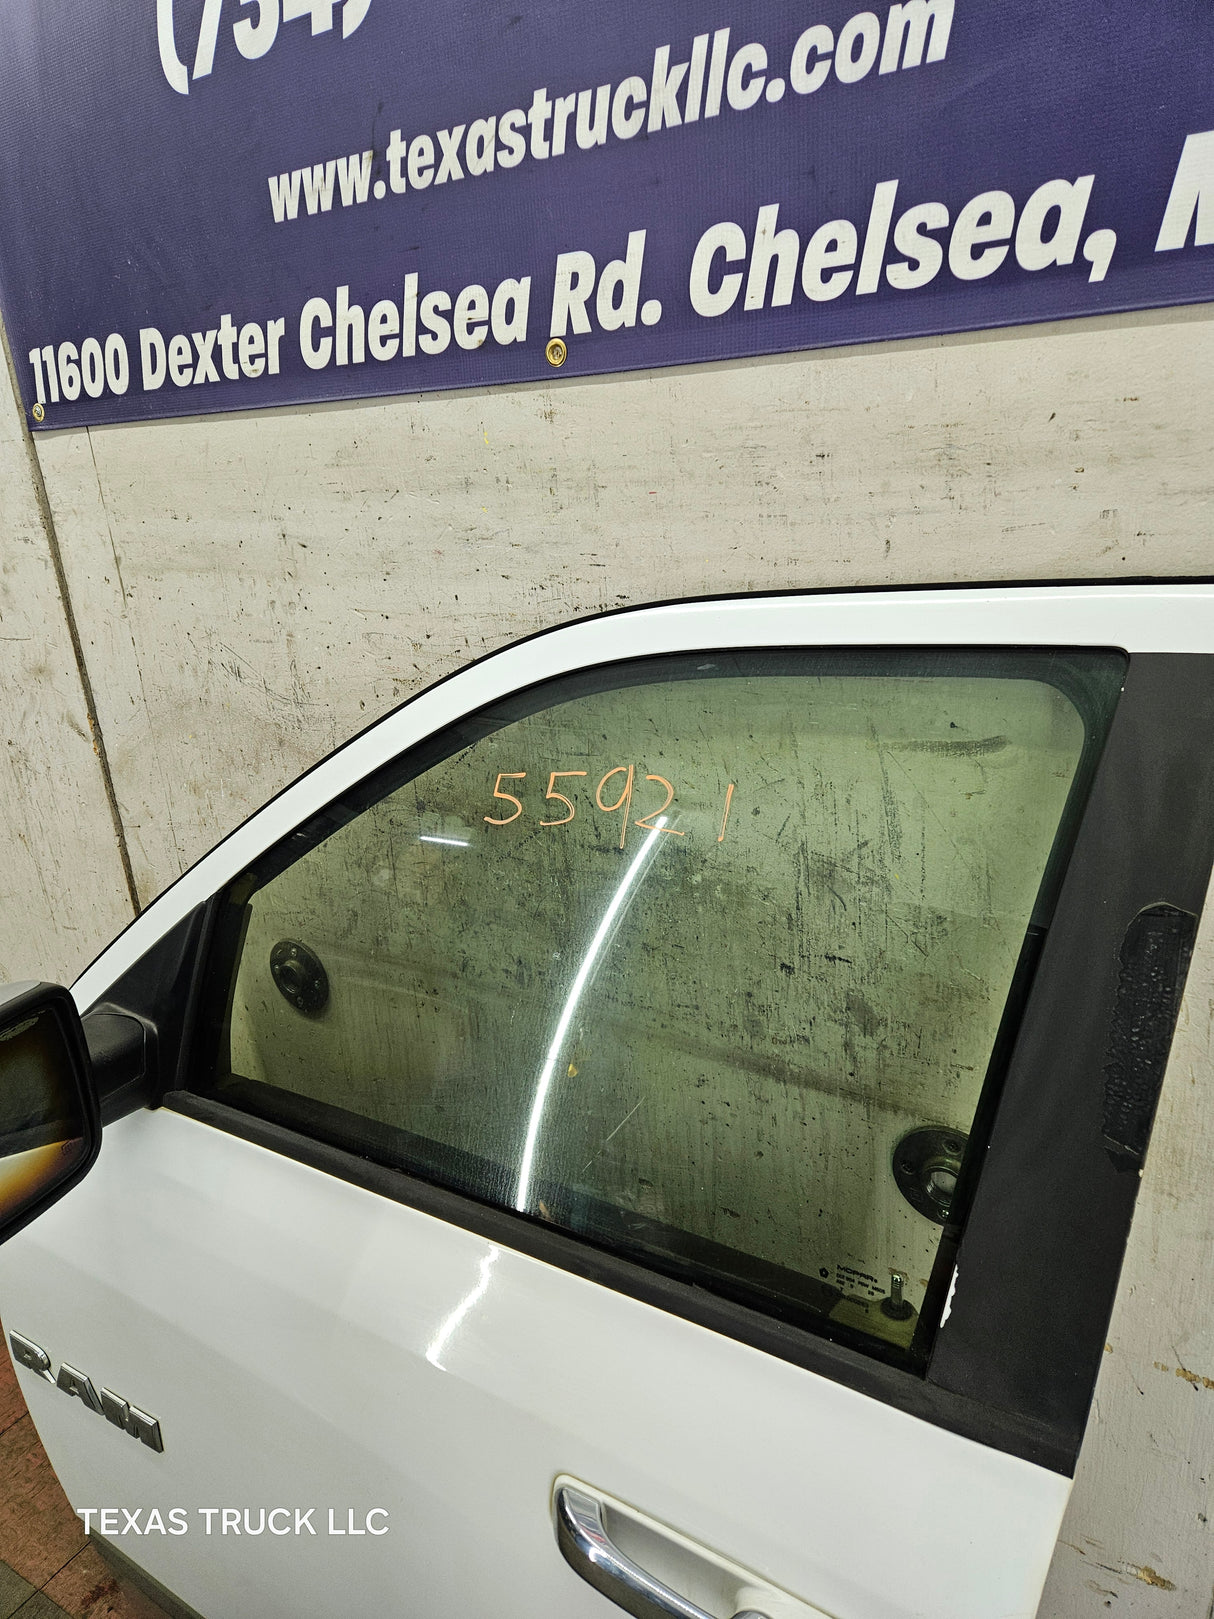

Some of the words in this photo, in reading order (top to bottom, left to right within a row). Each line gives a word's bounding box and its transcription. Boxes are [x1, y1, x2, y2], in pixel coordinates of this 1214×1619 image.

[268, 0, 955, 223] www.texastruckllc.com
[29, 333, 129, 404] 11600
[140, 313, 284, 391] Dexter
[299, 272, 531, 370] Chelsea
[550, 229, 662, 338] Rd.
[689, 174, 1117, 318] Chelsea,
[9, 1329, 164, 1453] RAM
